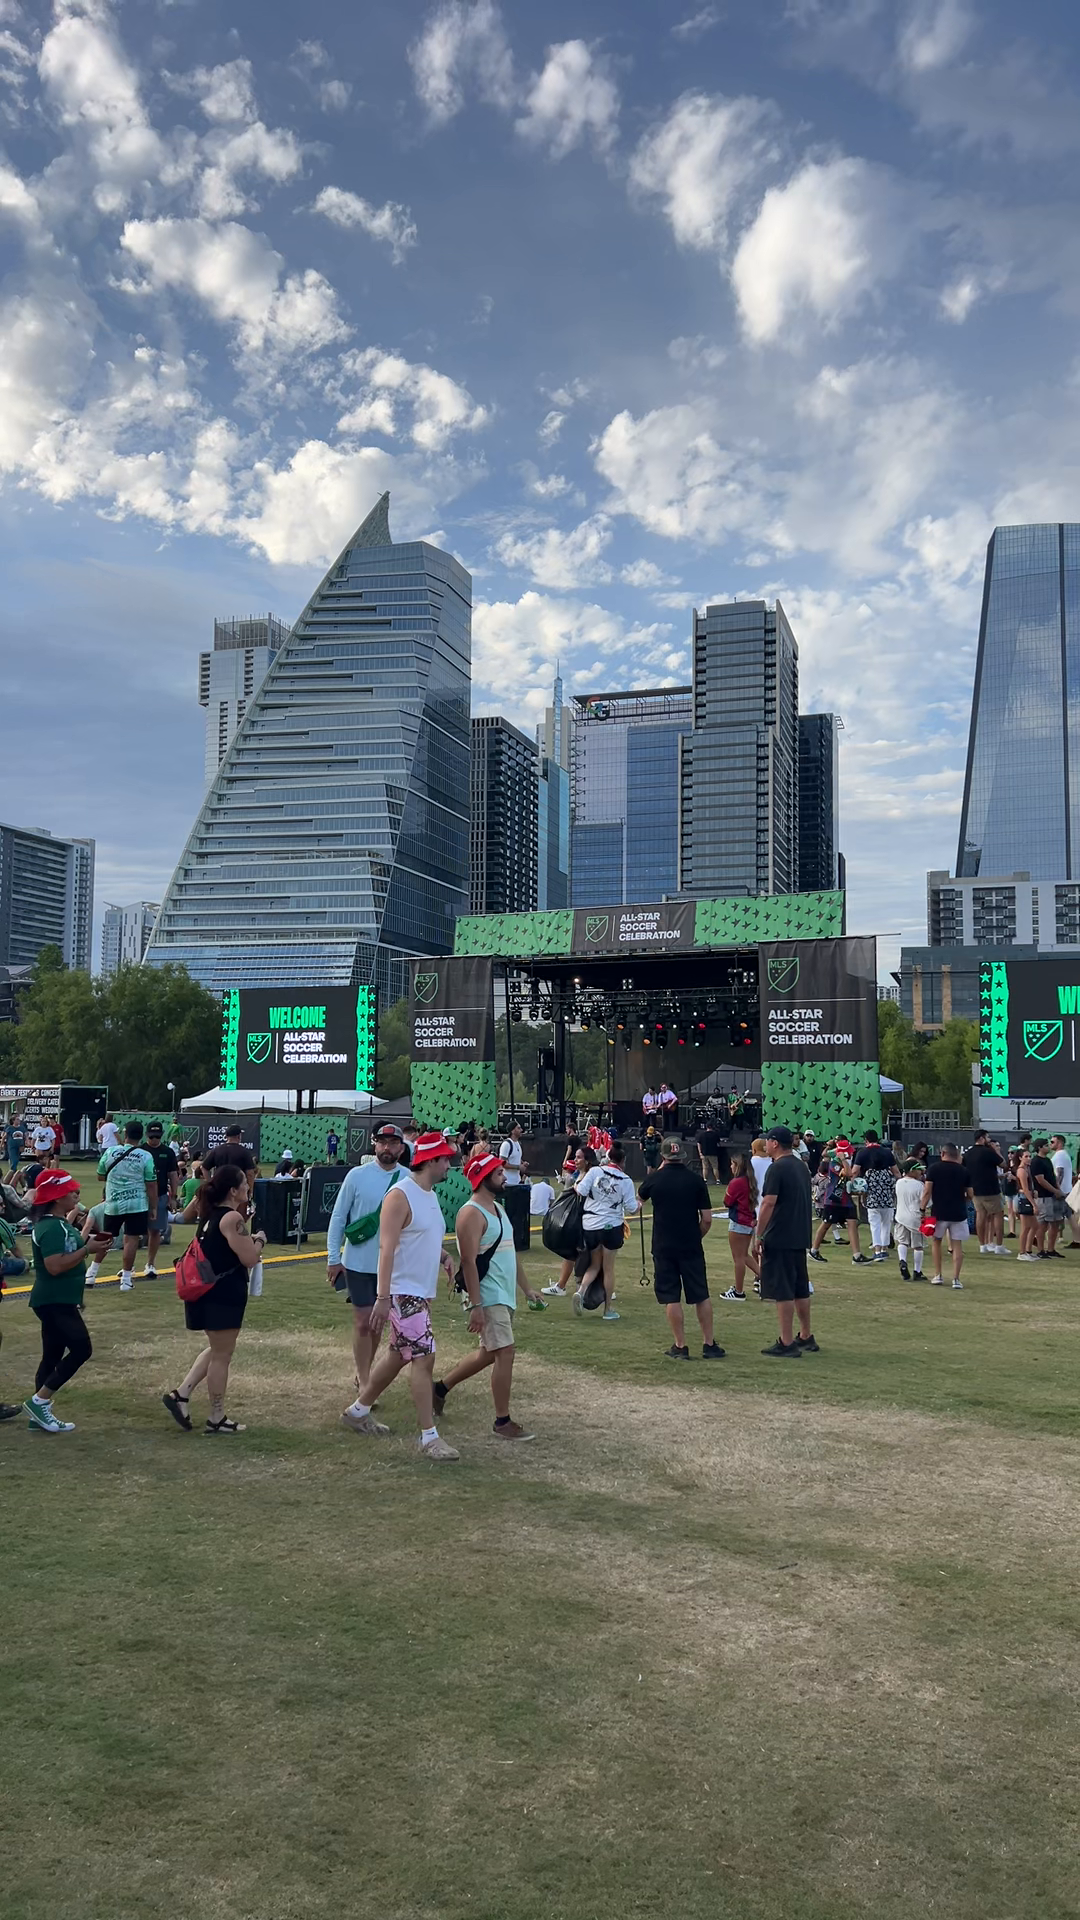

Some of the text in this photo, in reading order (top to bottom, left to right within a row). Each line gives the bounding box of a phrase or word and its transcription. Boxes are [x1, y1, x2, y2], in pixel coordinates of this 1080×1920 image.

[587, 917, 599, 925] MLS
[620, 912, 660, 922] ALL-STAR
[619, 922, 657, 932] SOCCER
[619, 930, 680, 941] CELEBRATION
[269, 1006, 327, 1028] WELCOME
[768, 1009, 823, 1019] ALL-STAR
[414, 1016, 455, 1026] ALL-STAR
[768, 1022, 820, 1032] SOCCER
[1026, 1024, 1048, 1032] MLS
[283, 1032, 325, 1041] ALL-STAR
[414, 1028, 453, 1037] SOCCER
[415, 1038, 477, 1048] CELEBRATION
[769, 1034, 852, 1045] CELEBRATION
[283, 1043, 323, 1052] SOCCER
[283, 1054, 347, 1063] CELEBRATION
[17, 1089, 40, 1097] FESTS
